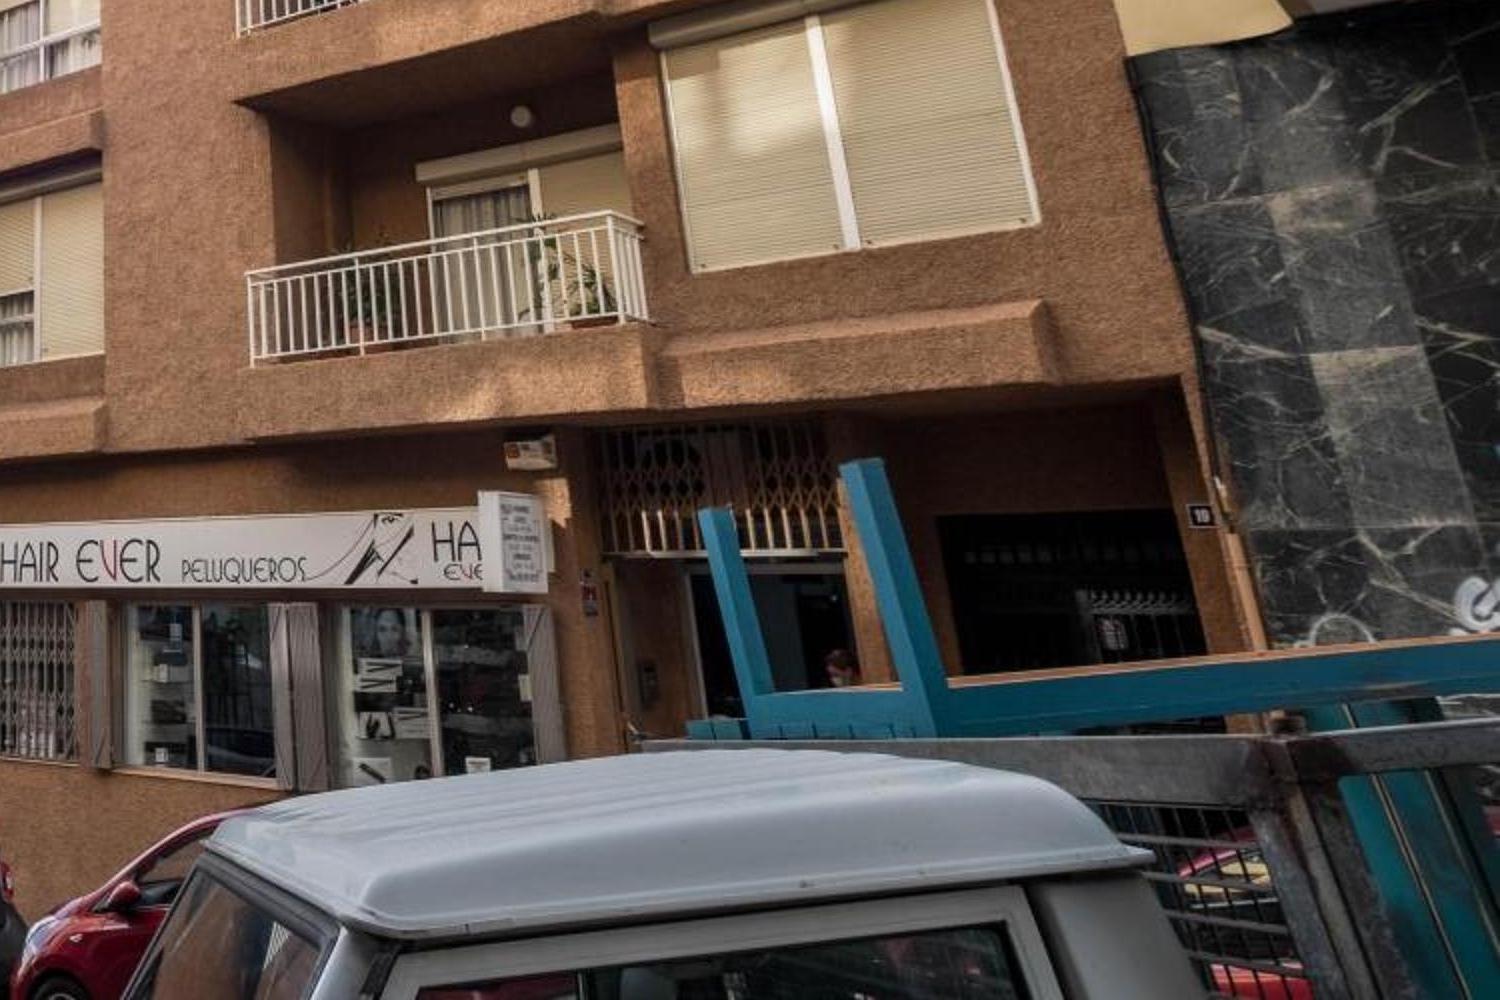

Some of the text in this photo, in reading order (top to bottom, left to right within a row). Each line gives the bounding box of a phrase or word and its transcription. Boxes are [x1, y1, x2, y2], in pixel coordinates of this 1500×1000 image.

[0, 538, 307, 584] HAIR EVER PELUQUEROS
